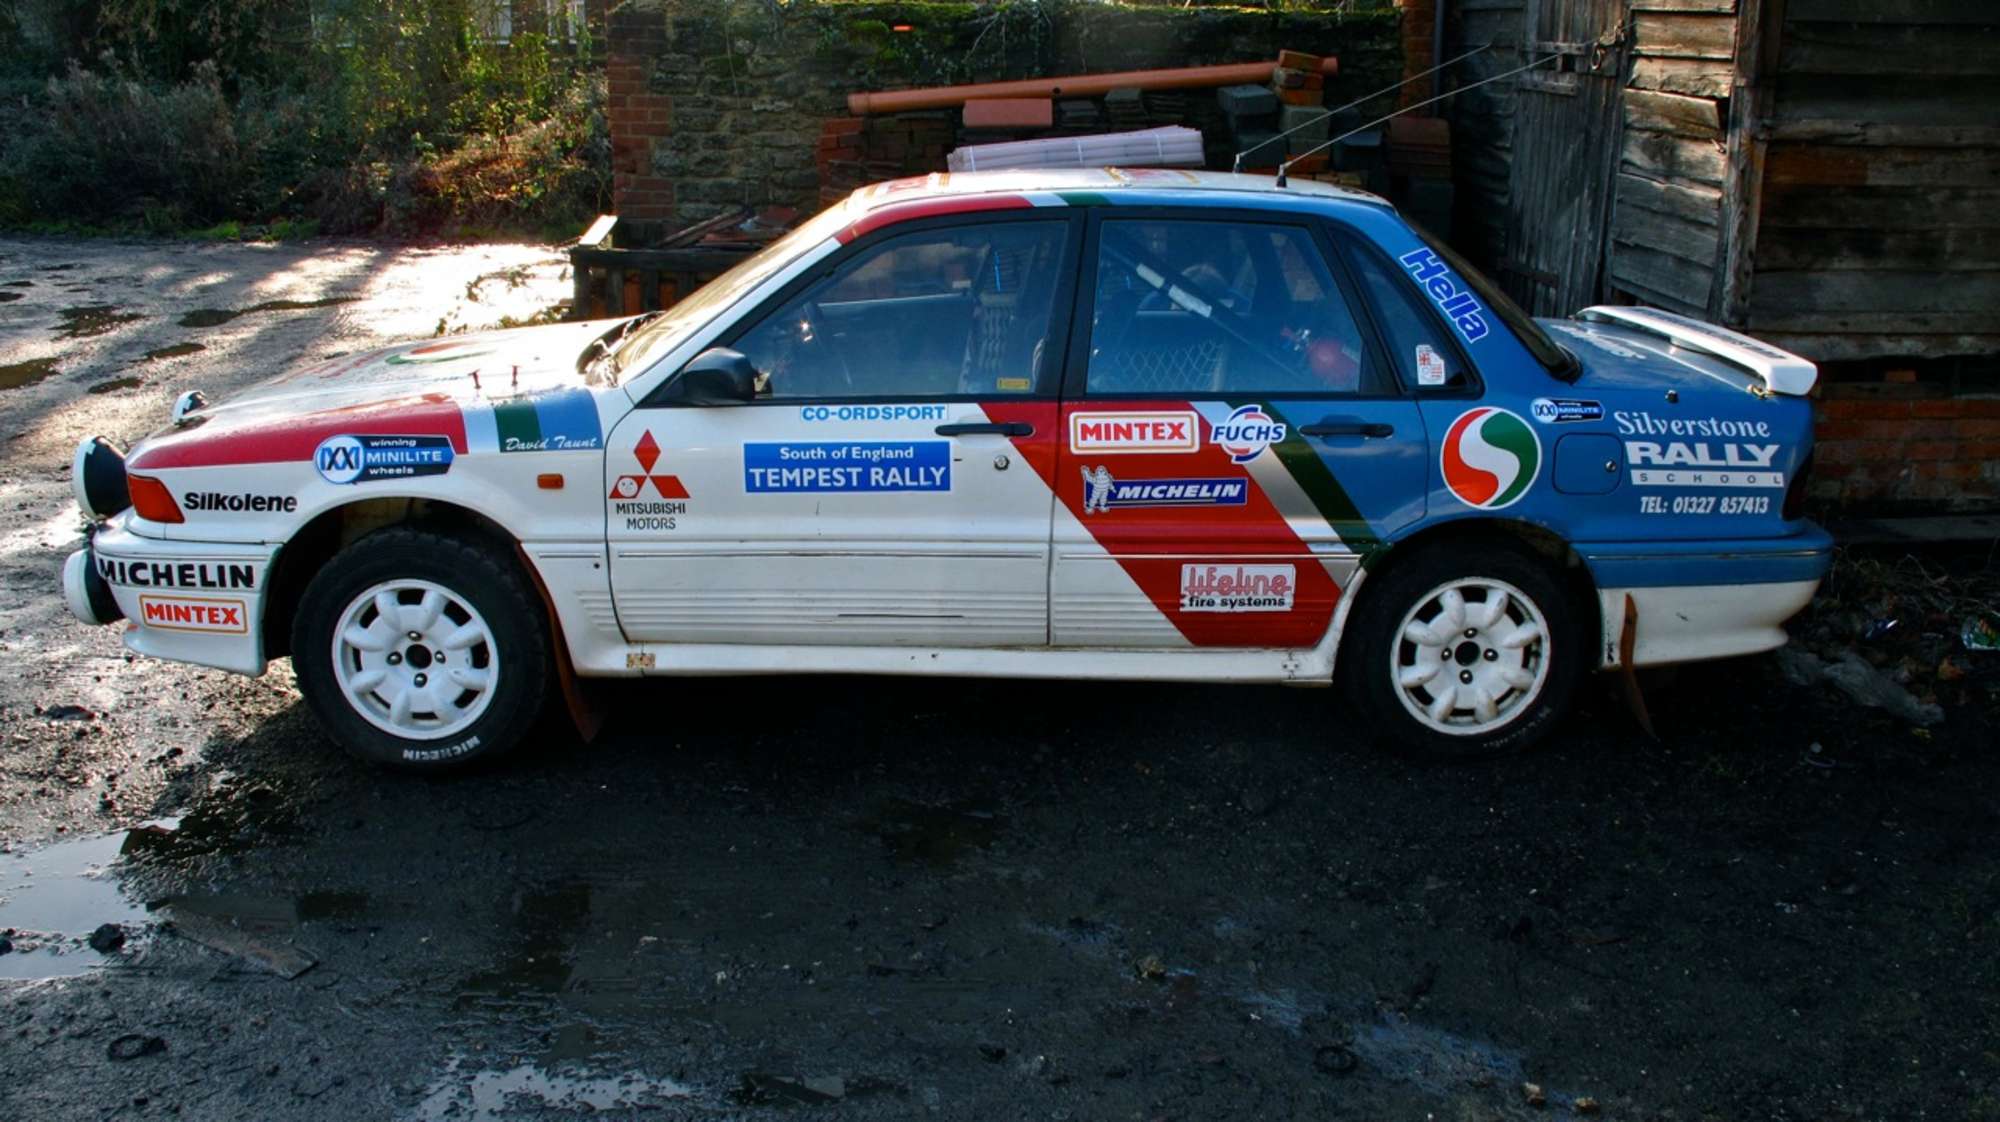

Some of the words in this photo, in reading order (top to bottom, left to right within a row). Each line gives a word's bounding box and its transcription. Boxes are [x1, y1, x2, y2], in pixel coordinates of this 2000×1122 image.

[1400, 247, 1489, 344] Hella
[802, 406, 945, 421] CO-ORDSPORT
[1080, 422, 1186, 441] MINTEX
[1613, 411, 1771, 438] Silverstone
[1213, 425, 1284, 441] FUCHS
[370, 439, 417, 447] winning
[505, 437, 549, 451] David
[554, 436, 597, 448] Taunt
[366, 450, 442, 463] MINILITE
[780, 447, 826, 460] South
[831, 446, 848, 459] of
[852, 446, 914, 463] England
[1624, 441, 1780, 467] RALLY
[368, 466, 414, 475] wheels
[749, 467, 863, 487] TEMPEST
[871, 466, 945, 486] RALLY
[1640, 473, 1781, 485] SCHOOL
[1117, 484, 1242, 500] MICHELIN
[184, 492, 297, 512] Silkolene
[616, 503, 686, 515] MITSUBISHI
[1640, 496, 1668, 513] TEL:
[1673, 496, 1716, 514] 01327
[1720, 497, 1770, 514] 857413
[626, 518, 676, 530] MOTORS
[99, 558, 254, 588] MICHELIN
[1189, 597, 1216, 607] fire
[1220, 597, 1286, 609] systems
[145, 603, 240, 626] MINTEX
